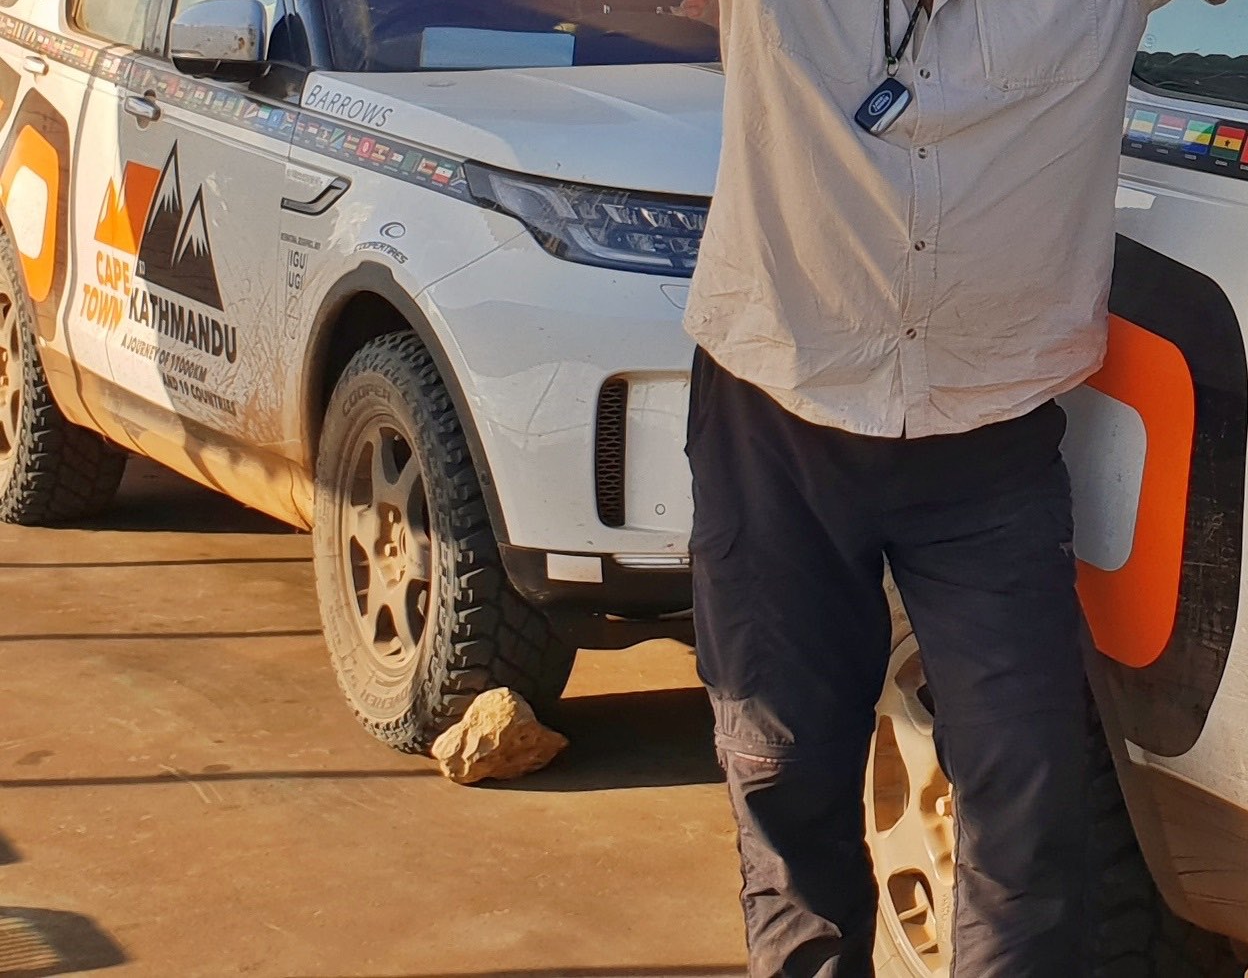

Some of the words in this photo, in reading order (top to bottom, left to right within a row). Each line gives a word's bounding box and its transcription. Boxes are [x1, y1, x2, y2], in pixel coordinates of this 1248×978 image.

[305, 84, 394, 127] BARROWS
[96, 250, 131, 296] CAPE
[80, 283, 124, 333] TOWN
[128, 287, 237, 364] KATHMANDU
